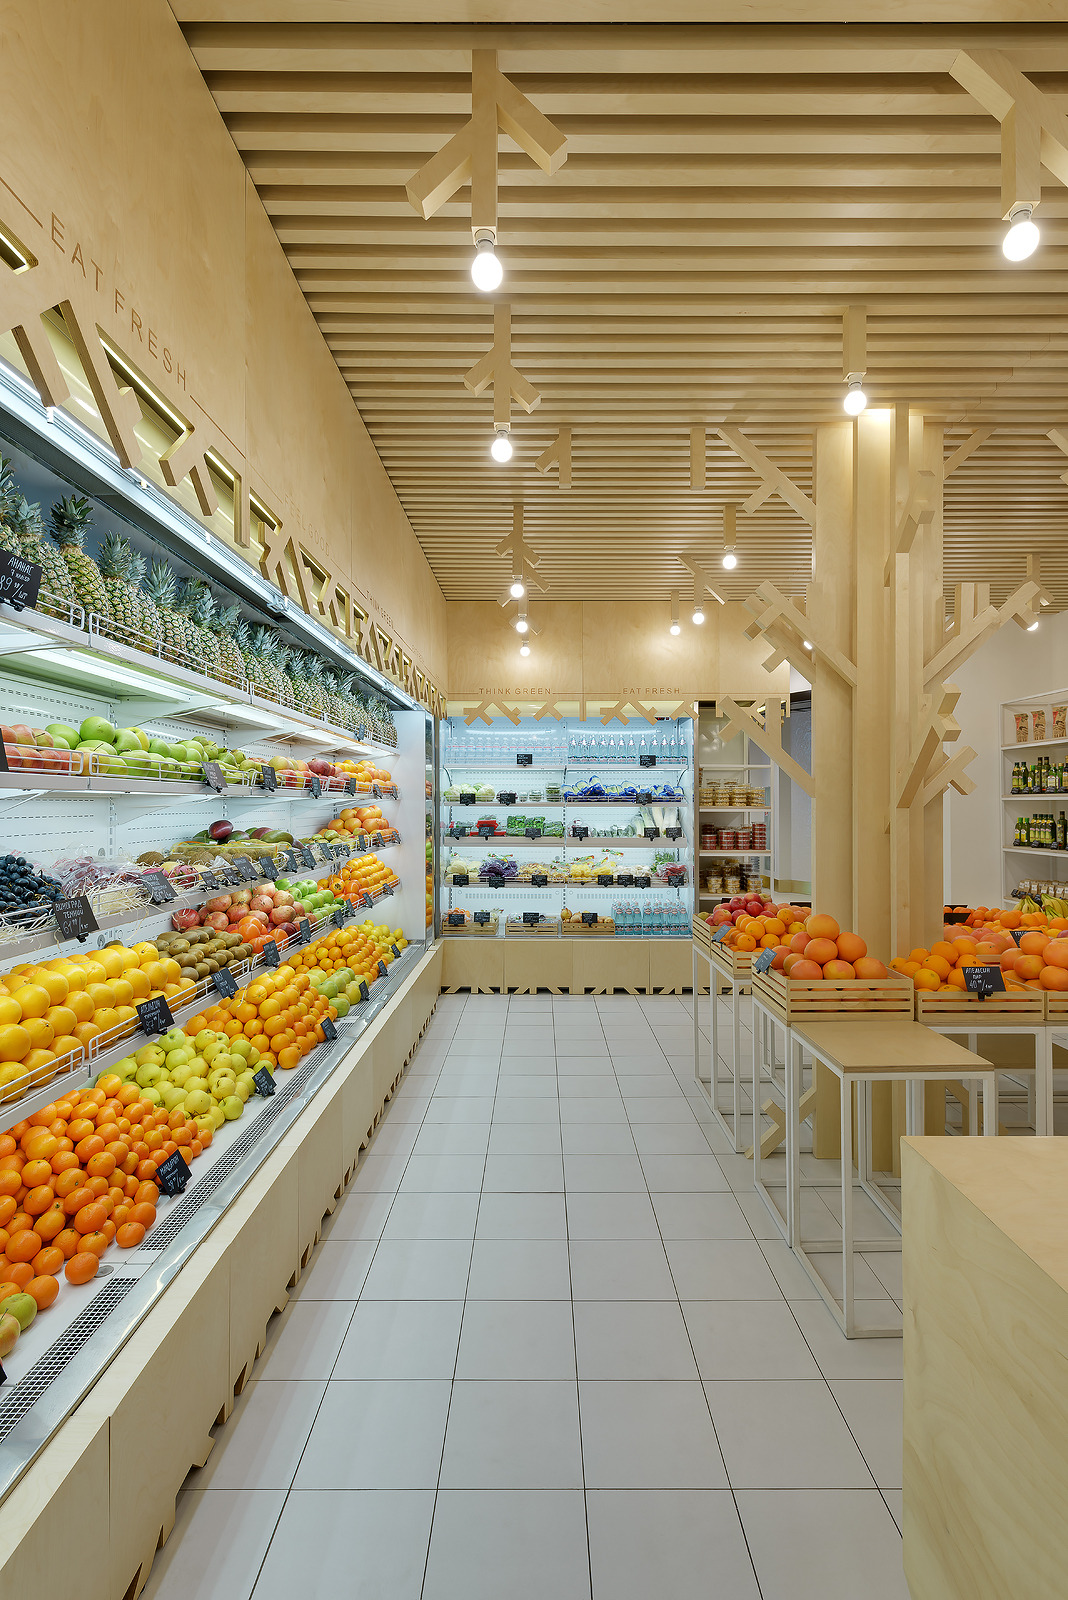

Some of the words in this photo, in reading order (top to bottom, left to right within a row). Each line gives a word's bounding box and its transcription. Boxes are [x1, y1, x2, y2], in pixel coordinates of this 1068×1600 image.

[51, 211, 104, 292] EAT
[114, 288, 187, 392] FRESH
[308, 522, 330, 557] GOOD
[478, 687, 512, 696] THINK
[514, 687, 552, 696] GREEN
[622, 687, 642, 696] EAT
[645, 687, 681, 696] FRESH
